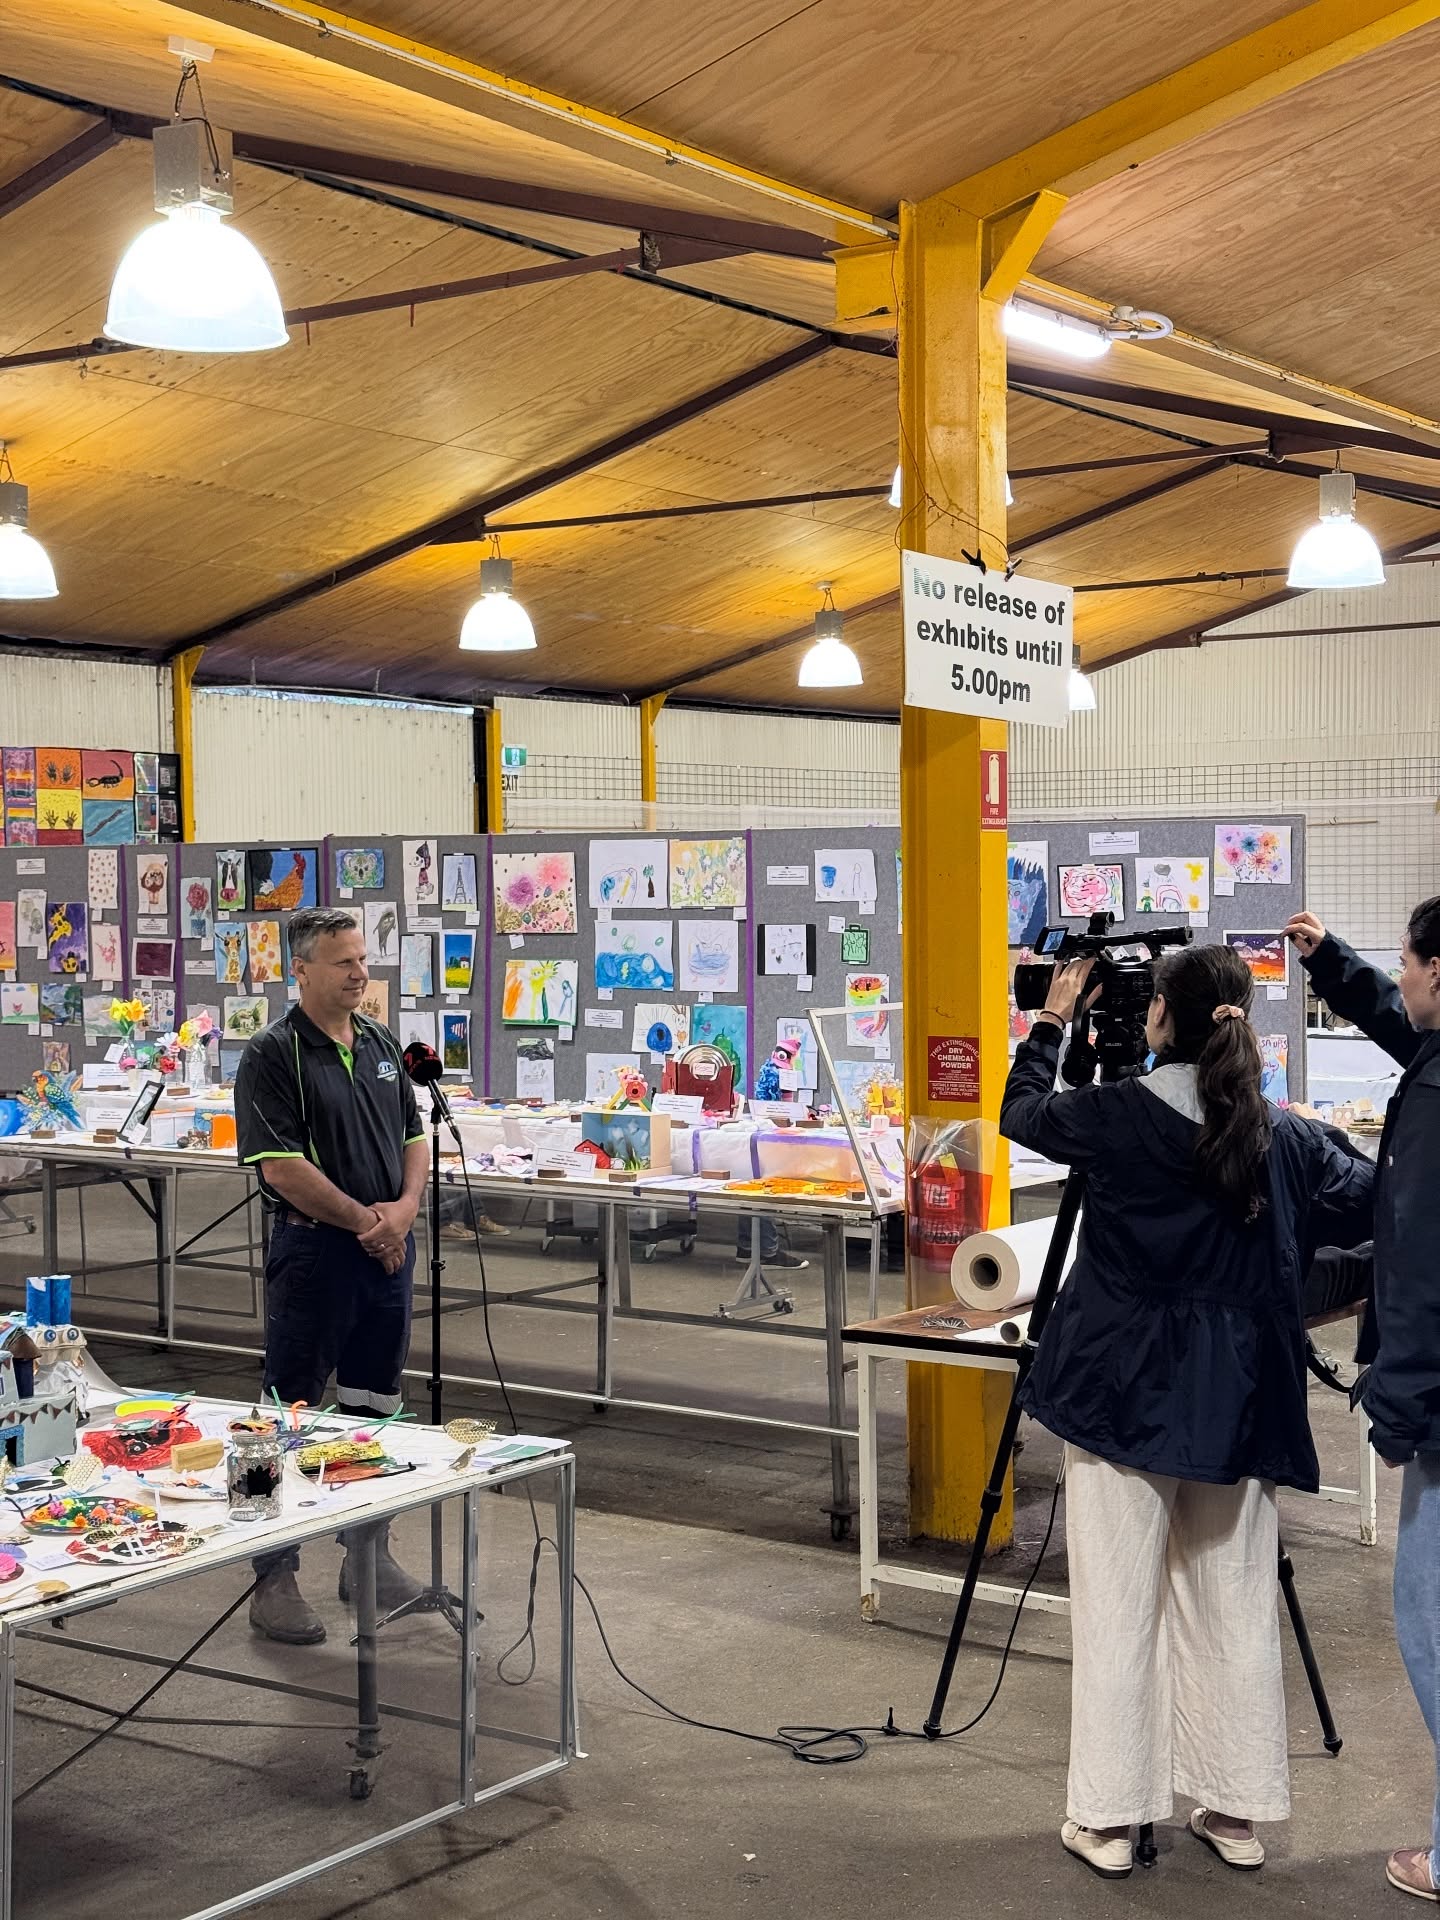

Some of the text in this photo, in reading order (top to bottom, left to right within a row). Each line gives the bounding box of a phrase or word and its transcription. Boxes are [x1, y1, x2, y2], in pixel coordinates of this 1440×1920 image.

[913, 568, 1065, 625] No release of
[917, 619, 1062, 666] exhibits until
[951, 664, 1030, 705] 5.00pm
[930, 1045, 942, 1058] THIS
[937, 1054, 975, 1062] CHEMICAL
